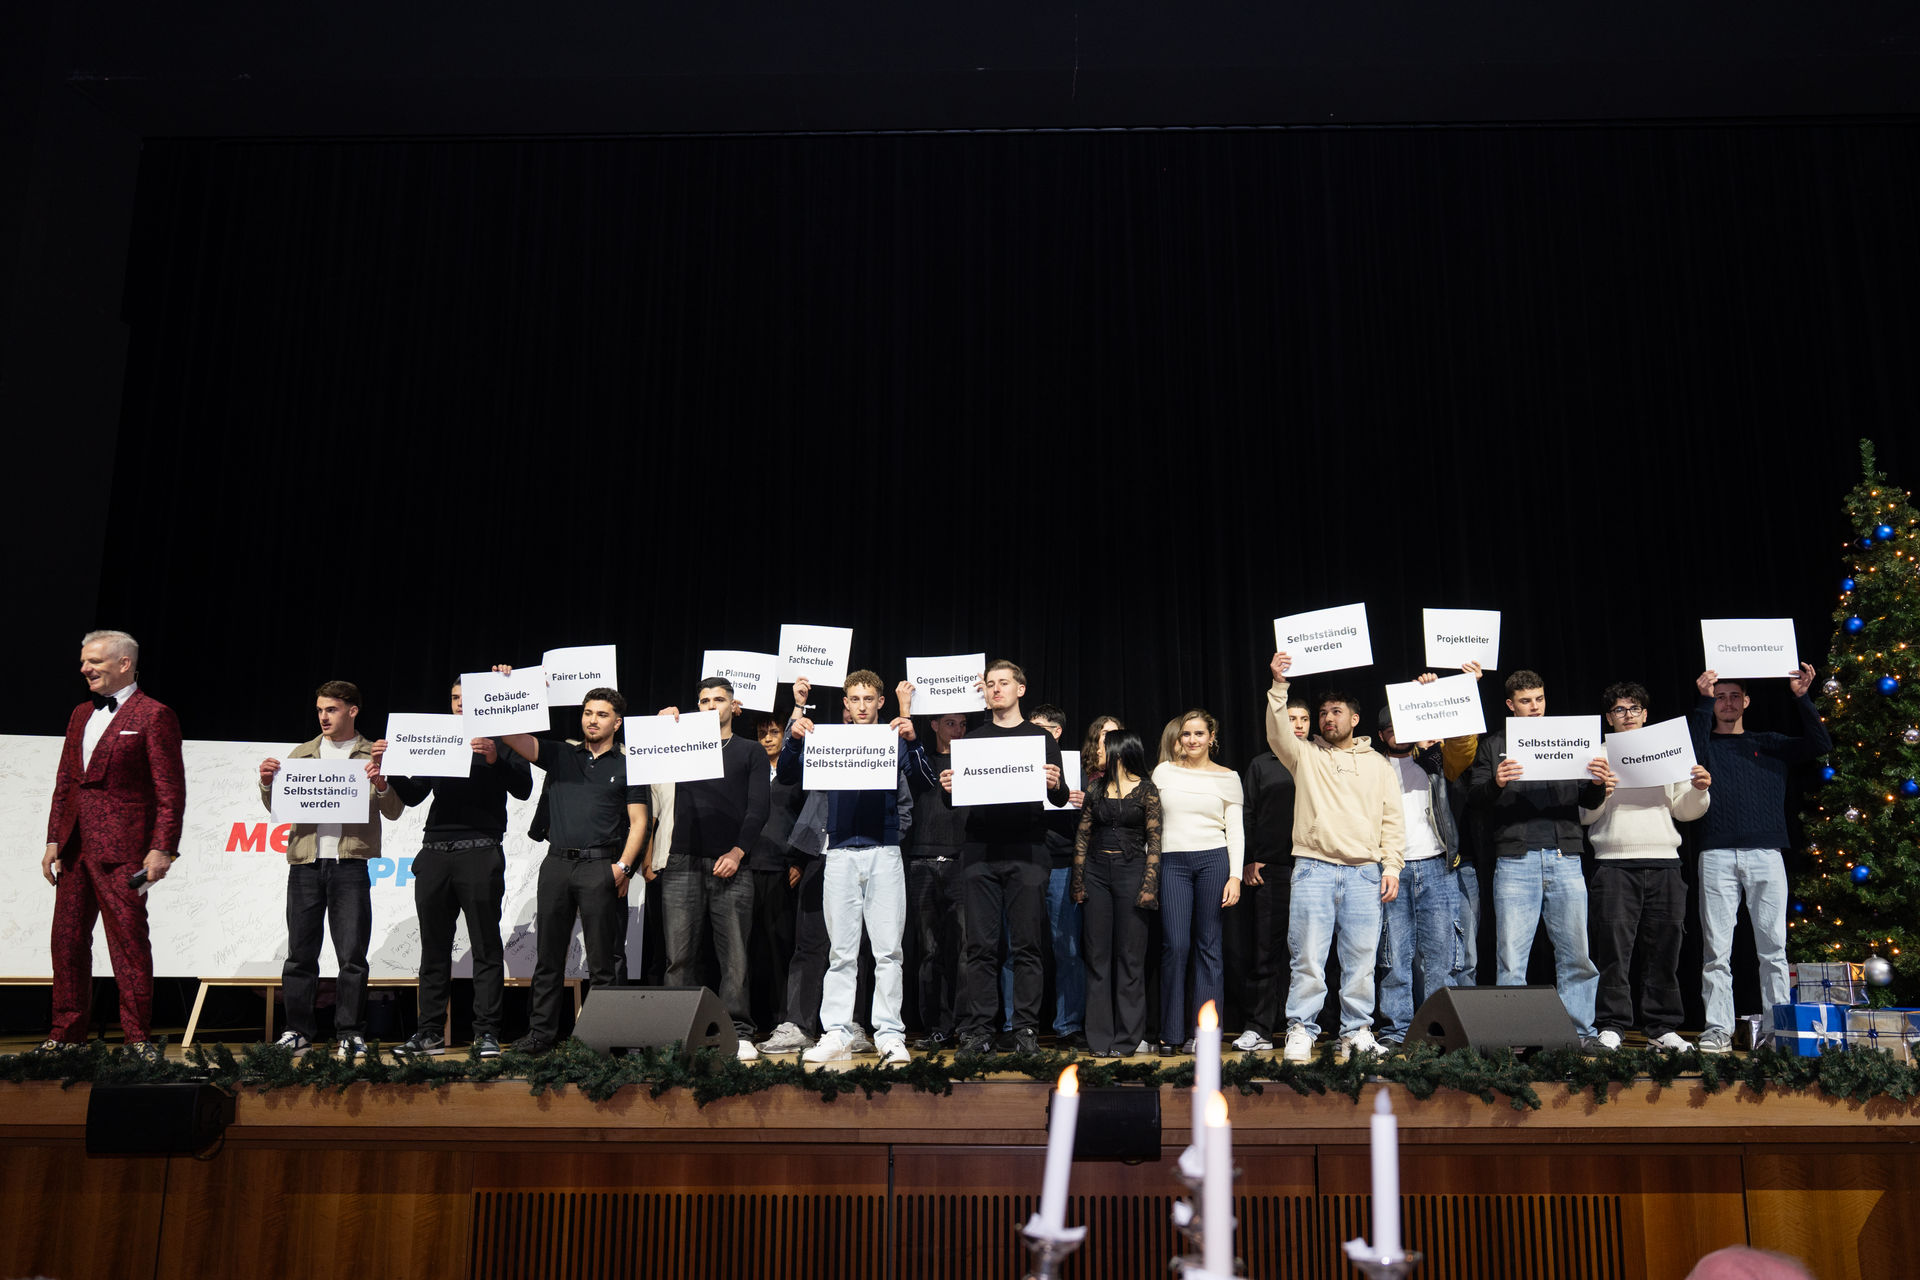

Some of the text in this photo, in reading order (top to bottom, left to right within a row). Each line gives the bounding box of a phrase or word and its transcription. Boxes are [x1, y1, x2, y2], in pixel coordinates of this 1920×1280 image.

[1287, 626, 1357, 644] Selbstständig
[1436, 634, 1490, 645] Projektleiter
[796, 643, 827, 655] Höhere
[1304, 641, 1343, 653] werden
[1717, 643, 1784, 653] Chefmonteur
[788, 655, 834, 667] Fachschule
[552, 671, 601, 681] Fairer Lohn
[716, 669, 761, 682] In Planung
[916, 674, 978, 687] Gegenseitiger
[484, 690, 530, 703] Gebäude-
[930, 686, 966, 696] Respekt
[474, 702, 540, 717] technikplaner
[1399, 695, 1471, 712] Lehrabschluss
[1415, 709, 1458, 722] schaffen
[395, 733, 464, 746] Selbstständig
[1518, 738, 1590, 749] Selbstständig
[409, 747, 446, 756] werden
[629, 741, 719, 756] Servicetechniker
[806, 745, 896, 757] Meisterprüfung &
[1534, 751, 1574, 761] werden
[1621, 747, 1682, 766] Chefmonteur
[806, 758, 896, 770] Selbstständigkeit
[963, 764, 1034, 776] Aussendienst
[286, 773, 356, 783] Fairer Lohn &
[283, 786, 358, 798] Selbstständig
[300, 799, 341, 809] werden
